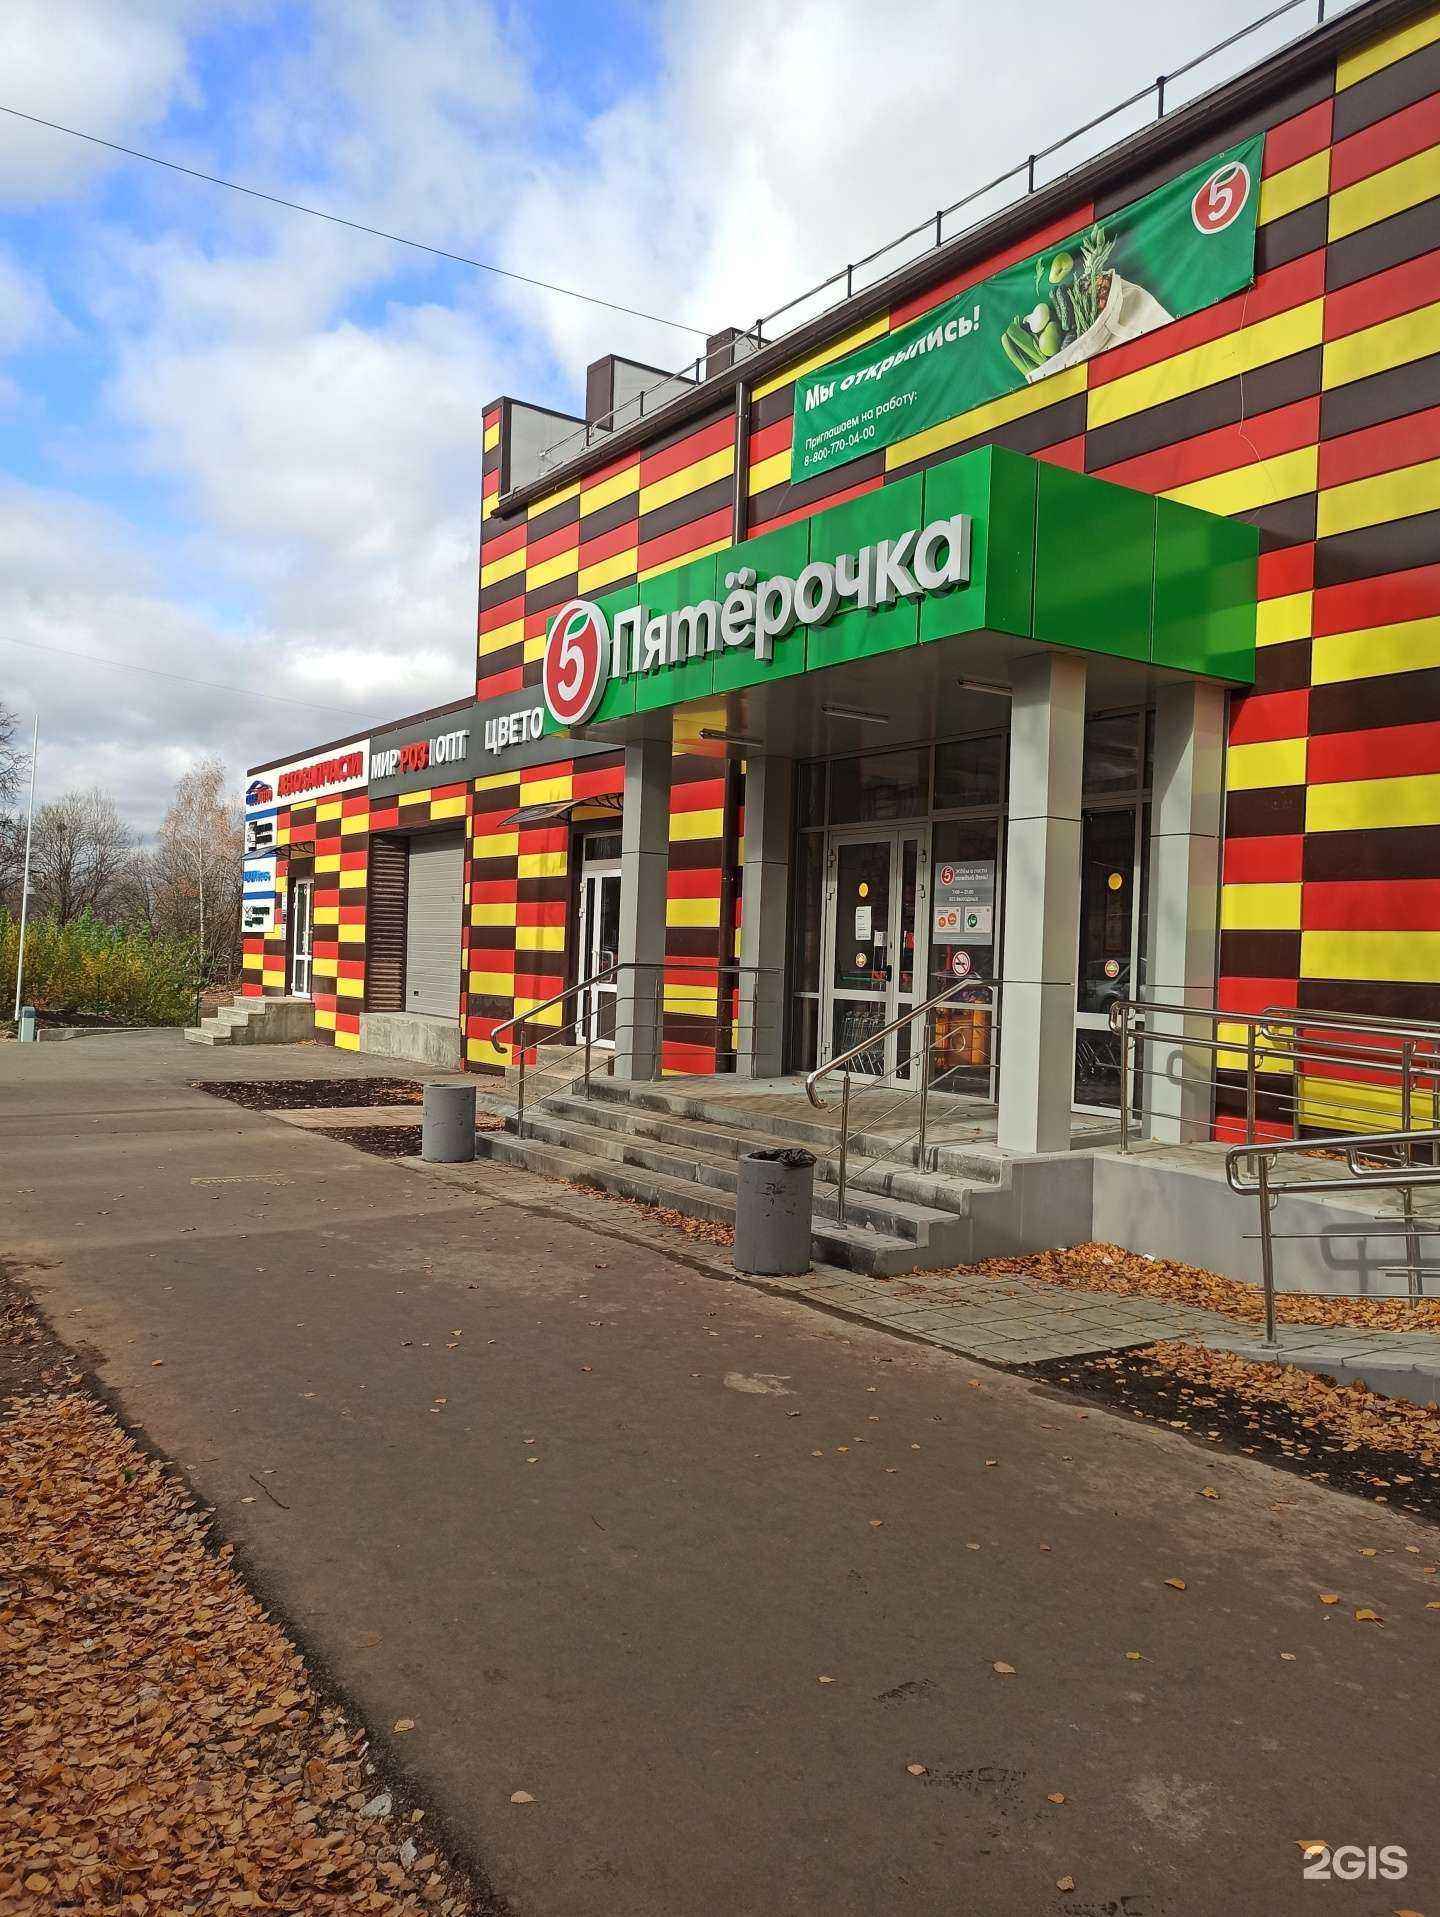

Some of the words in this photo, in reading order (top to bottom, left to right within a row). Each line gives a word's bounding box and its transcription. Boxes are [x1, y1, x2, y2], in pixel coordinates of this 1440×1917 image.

[805, 382, 836, 412] Мы
[805, 416, 859, 451] Приглашаем
[861, 408, 874, 420] на
[876, 392, 917, 418] работу:
[804, 426, 875, 465] 8-800-770-04-00
[611, 514, 971, 678] Пятёрочка
